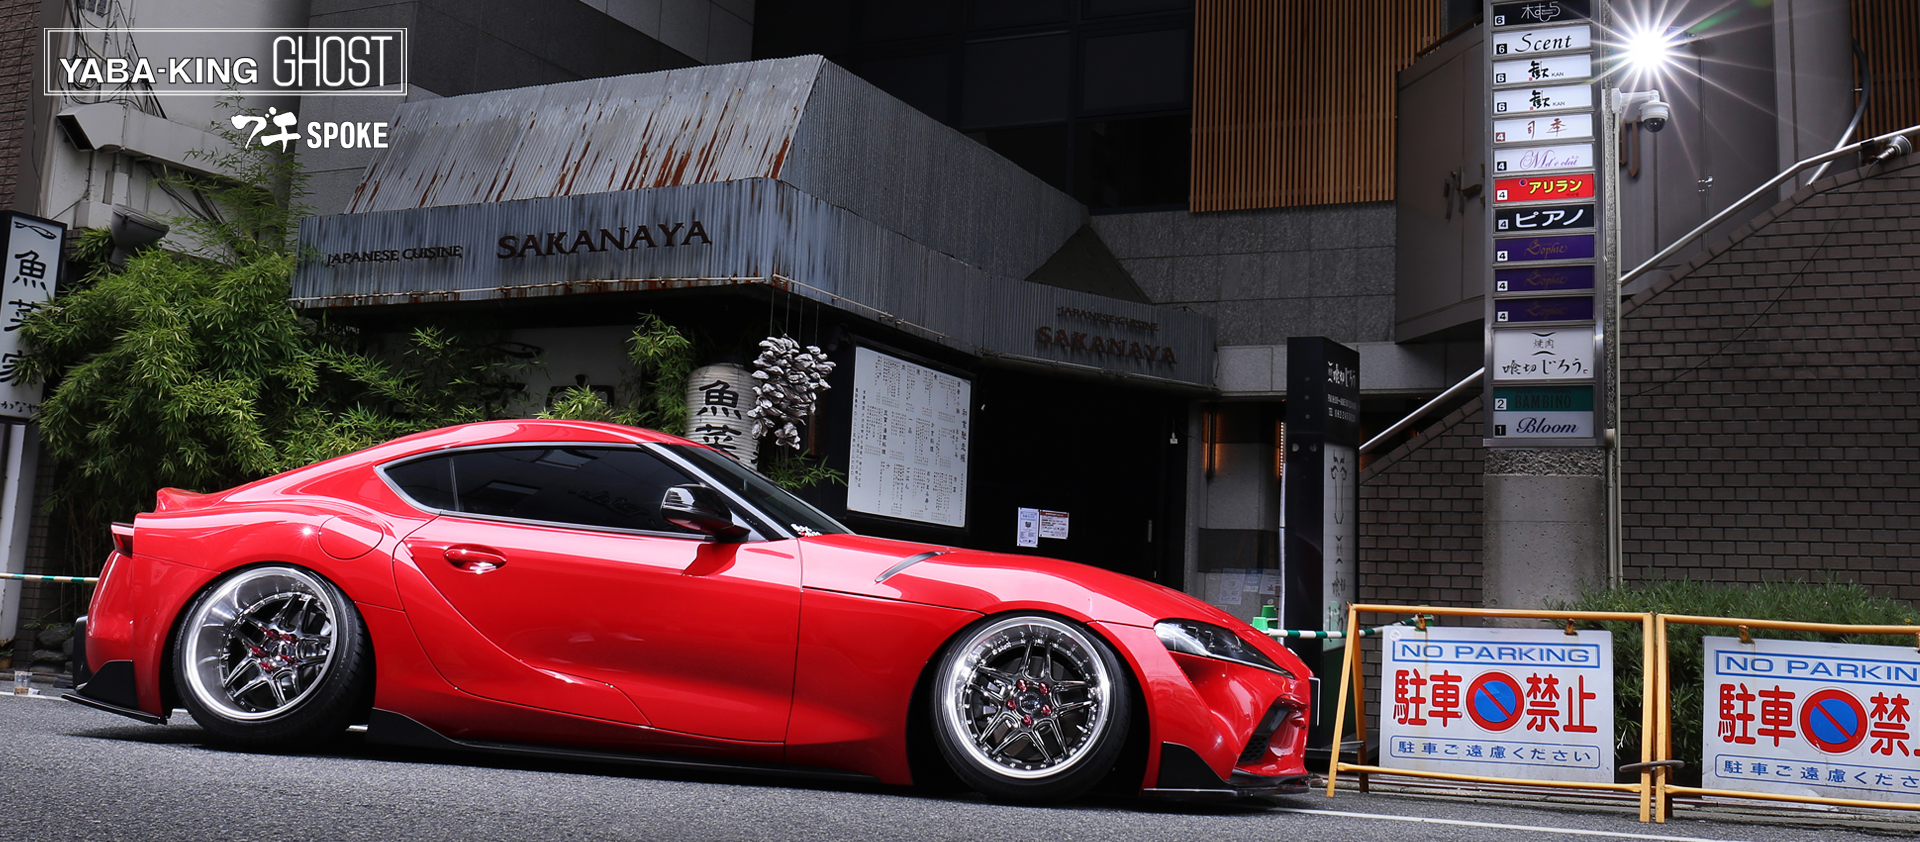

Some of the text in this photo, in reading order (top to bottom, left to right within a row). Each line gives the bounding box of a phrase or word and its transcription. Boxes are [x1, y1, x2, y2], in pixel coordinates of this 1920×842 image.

[1515, 33, 1572, 53] Scent
[1529, 180, 1583, 194] アリラン
[1516, 208, 1584, 228] ピアノ
[496, 220, 713, 259] SAKANAYA
[327, 246, 464, 267] JAPANESE CUISINE
[1057, 305, 1160, 332] JAPANESE CUISINE
[1036, 325, 1178, 365] SAKANAYA
[1497, 394, 1572, 409] 2 BAMBINO
[1516, 416, 1579, 434] Bloom
[1401, 644, 1591, 663] NO PARKING
[1726, 656, 1918, 682] NO PARKIN
[1393, 668, 1598, 733] 駐車 禁止
[1717, 683, 1797, 748] 駐車
[1397, 740, 1591, 763] 駐車ご遠慮ください
